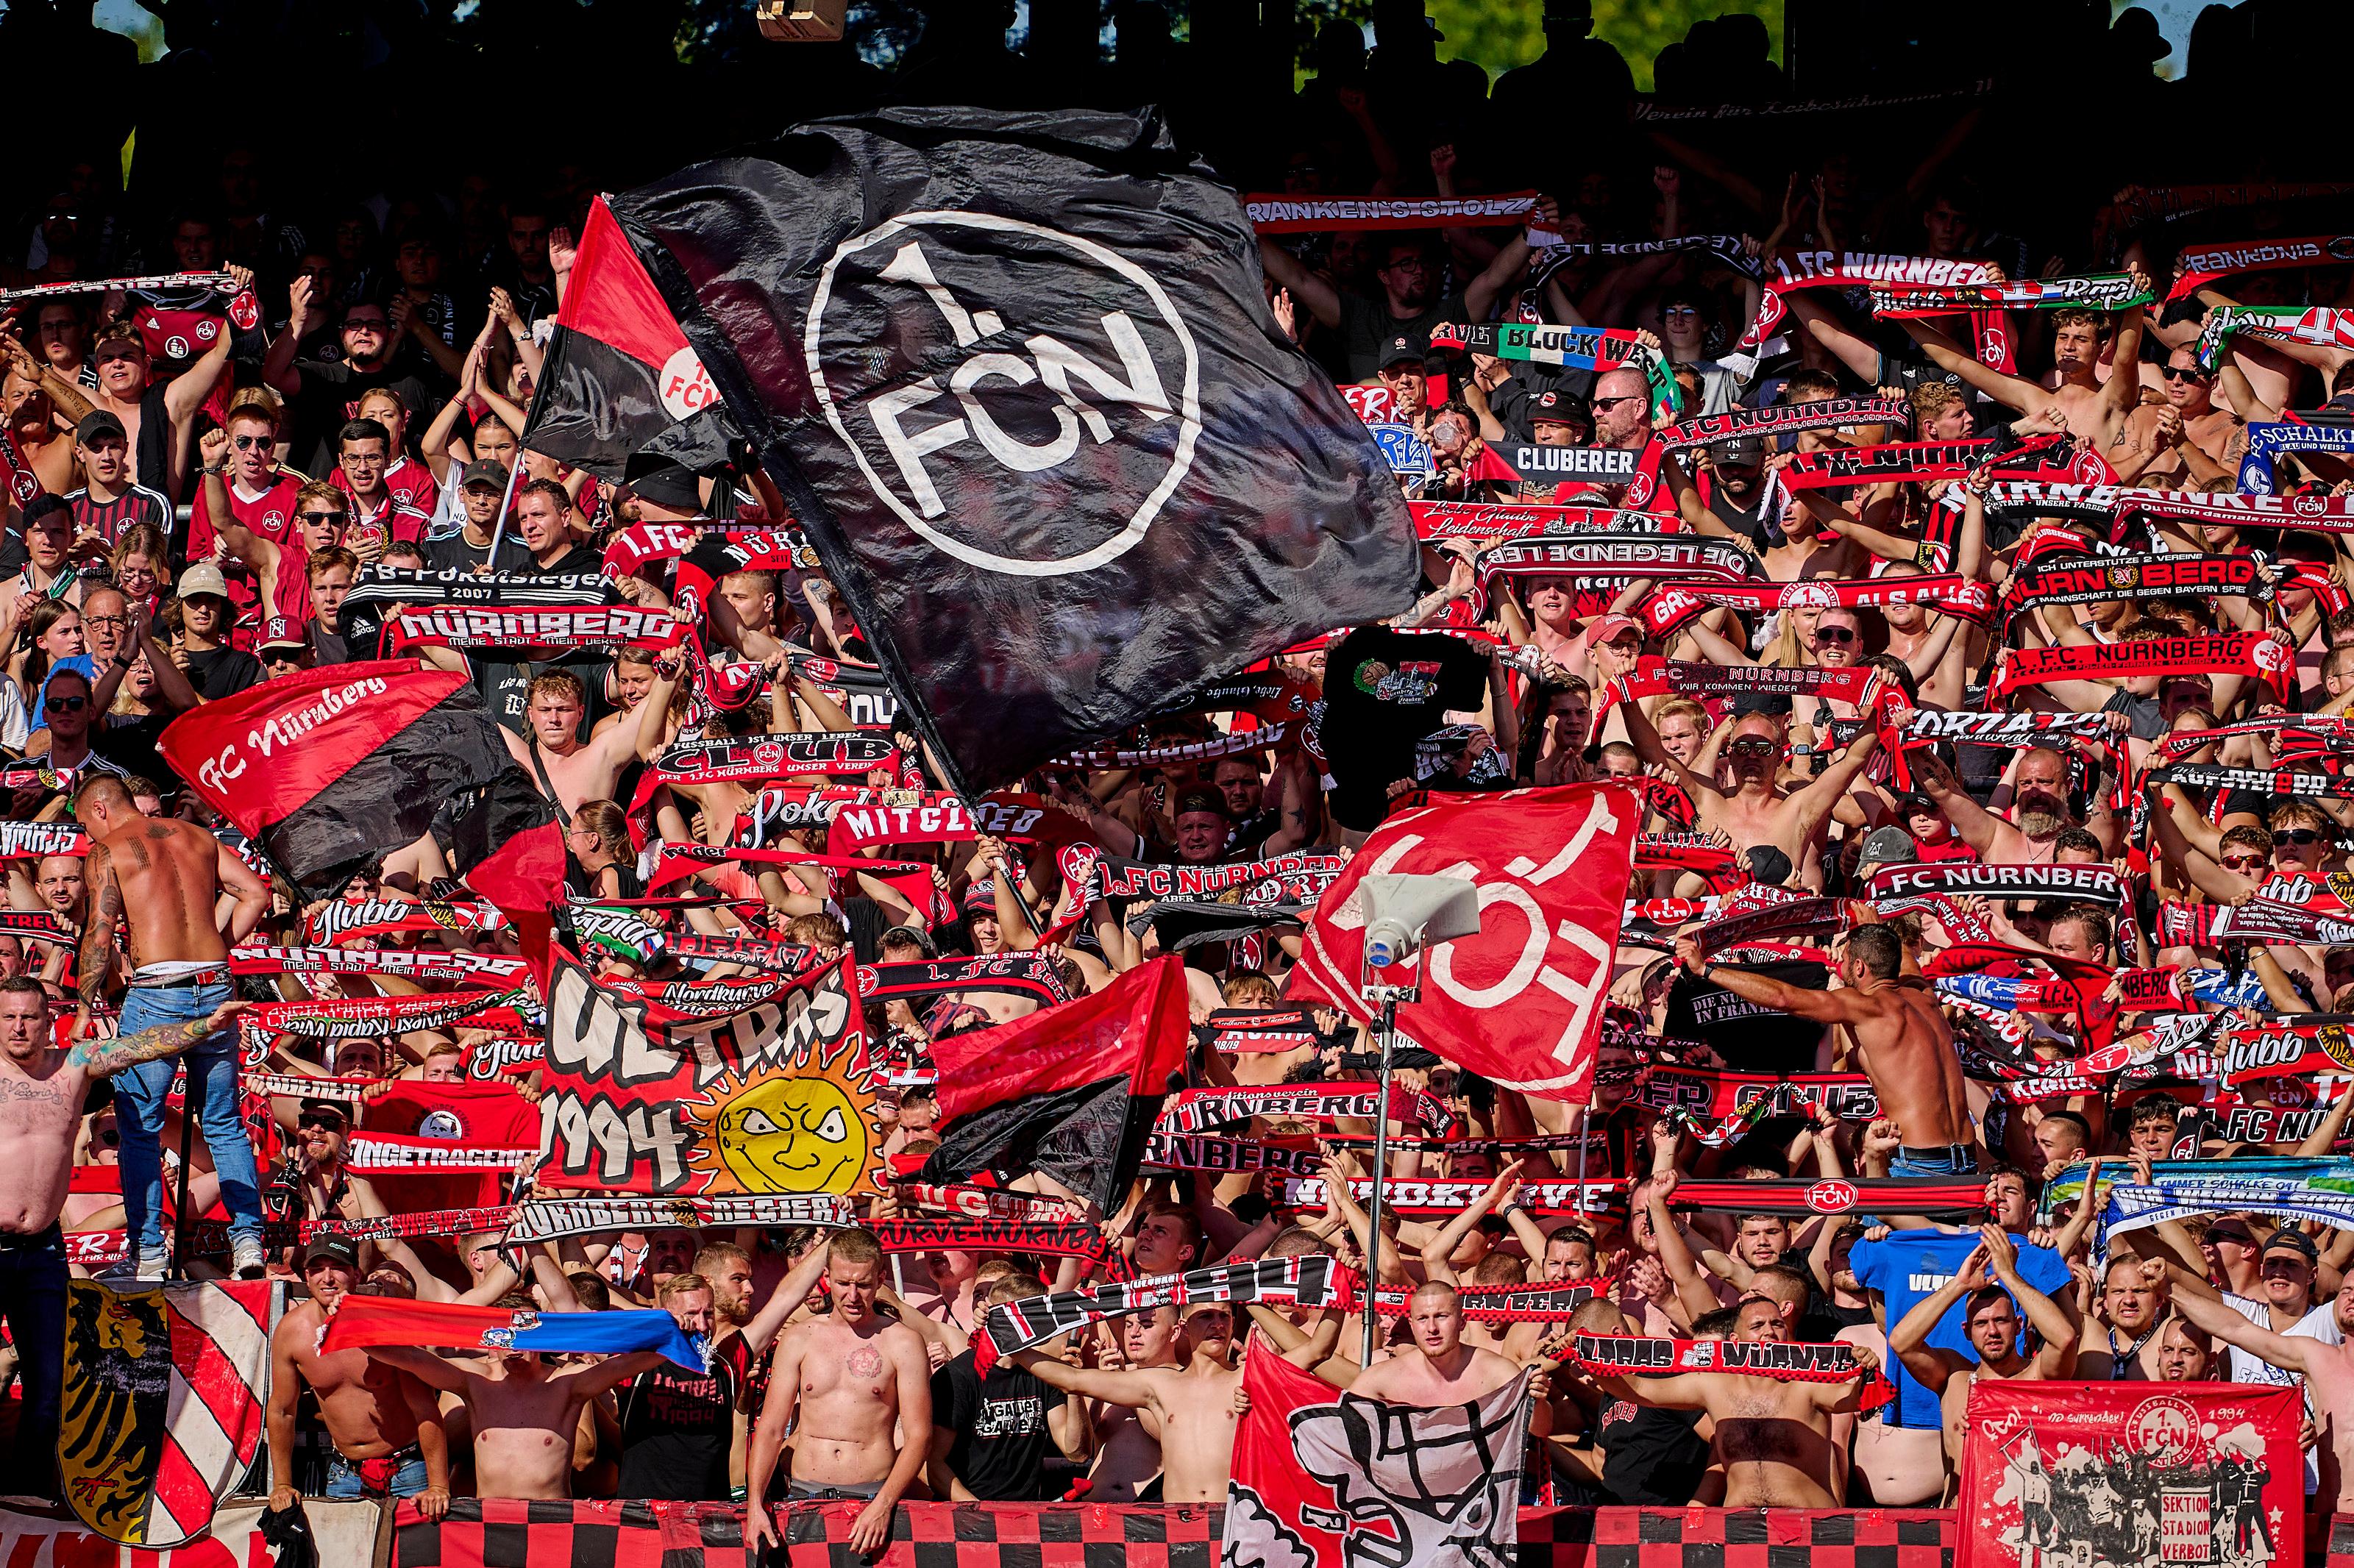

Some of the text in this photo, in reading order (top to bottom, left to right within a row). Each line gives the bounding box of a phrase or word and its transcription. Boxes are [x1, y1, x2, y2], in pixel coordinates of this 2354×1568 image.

[1245, 197, 1536, 221] RANKEN'S STOLZ
[2058, 274, 2141, 310] Rapi
[1507, 329, 1598, 358] BLOCK
[868, 310, 1175, 519] FCN
[2250, 434, 2264, 459] FC
[2279, 443, 2347, 452] BLAU UND WEISS
[1517, 447, 1635, 474] CLUBERER
[2035, 499, 2069, 510] UNSERE
[2141, 503, 2353, 529] Du mich damals mit zum Club
[1428, 516, 1541, 540] Leidenschaft
[620, 524, 690, 558] 1.FC
[1549, 542, 1751, 575] DIE LEGENDE
[2037, 564, 2056, 574] ICH
[2143, 556, 2152, 564] 2
[2156, 552, 2203, 562] VEREINE
[2142, 560, 2256, 588] BERG
[452, 588, 492, 600] 2007
[1857, 584, 1986, 610] ALS ALLES
[2039, 590, 2113, 603] MANNSCHAFT
[2116, 589, 2133, 599] DIE
[2136, 587, 2172, 596] GEGEN
[2175, 585, 2218, 594] BAYERN
[351, 624, 376, 638] adidas
[401, 608, 678, 639] NÜRNBERG
[449, 636, 629, 646] MEINE STADT MEIN VEREIN
[1653, 669, 1685, 681] FC
[1729, 666, 1852, 685] NÜRNBERG
[1679, 683, 1799, 694] WIR KOMMEN WIEDER
[673, 731, 862, 752] FUSSBALL IST UNSER LEBEN
[758, 750, 781, 761] FCN
[657, 773, 681, 782] DER
[716, 763, 780, 779] NÜRNBERG
[786, 762, 828, 773] UNSER
[836, 760, 877, 771] VEREIN
[1125, 866, 1174, 896] FC
[1893, 872, 1936, 890] FC
[1002, 951, 1034, 960] SIND
[282, 961, 466, 980] MEINE STADT MEIN VEREIN
[957, 959, 1011, 980] FC
[664, 981, 775, 1005] Nordkurve
[1692, 997, 1717, 1012] DIE
[551, 964, 848, 1087] ULTRAS
[1694, 1010, 1713, 1025] IN
[2269, 1091, 2301, 1104] FCN
[2227, 1108, 2272, 1142] FC
[541, 1091, 689, 1188] 1994
[1140, 1131, 1326, 1176] RNBERG
[2159, 1179, 2207, 1189] IMMER
[2210, 1179, 2274, 1190] SCHALKE
[1811, 1189, 1852, 1205] FCN
[2048, 1411, 2125, 1425] no surrender!
[2208, 1407, 2247, 1421] 1994
[2141, 1429, 2186, 1447] FCN
[2162, 1496, 2211, 1514] SEKTION
[2161, 1519, 2211, 1538] STADION
[2161, 1544, 2211, 1561] VERBOT
